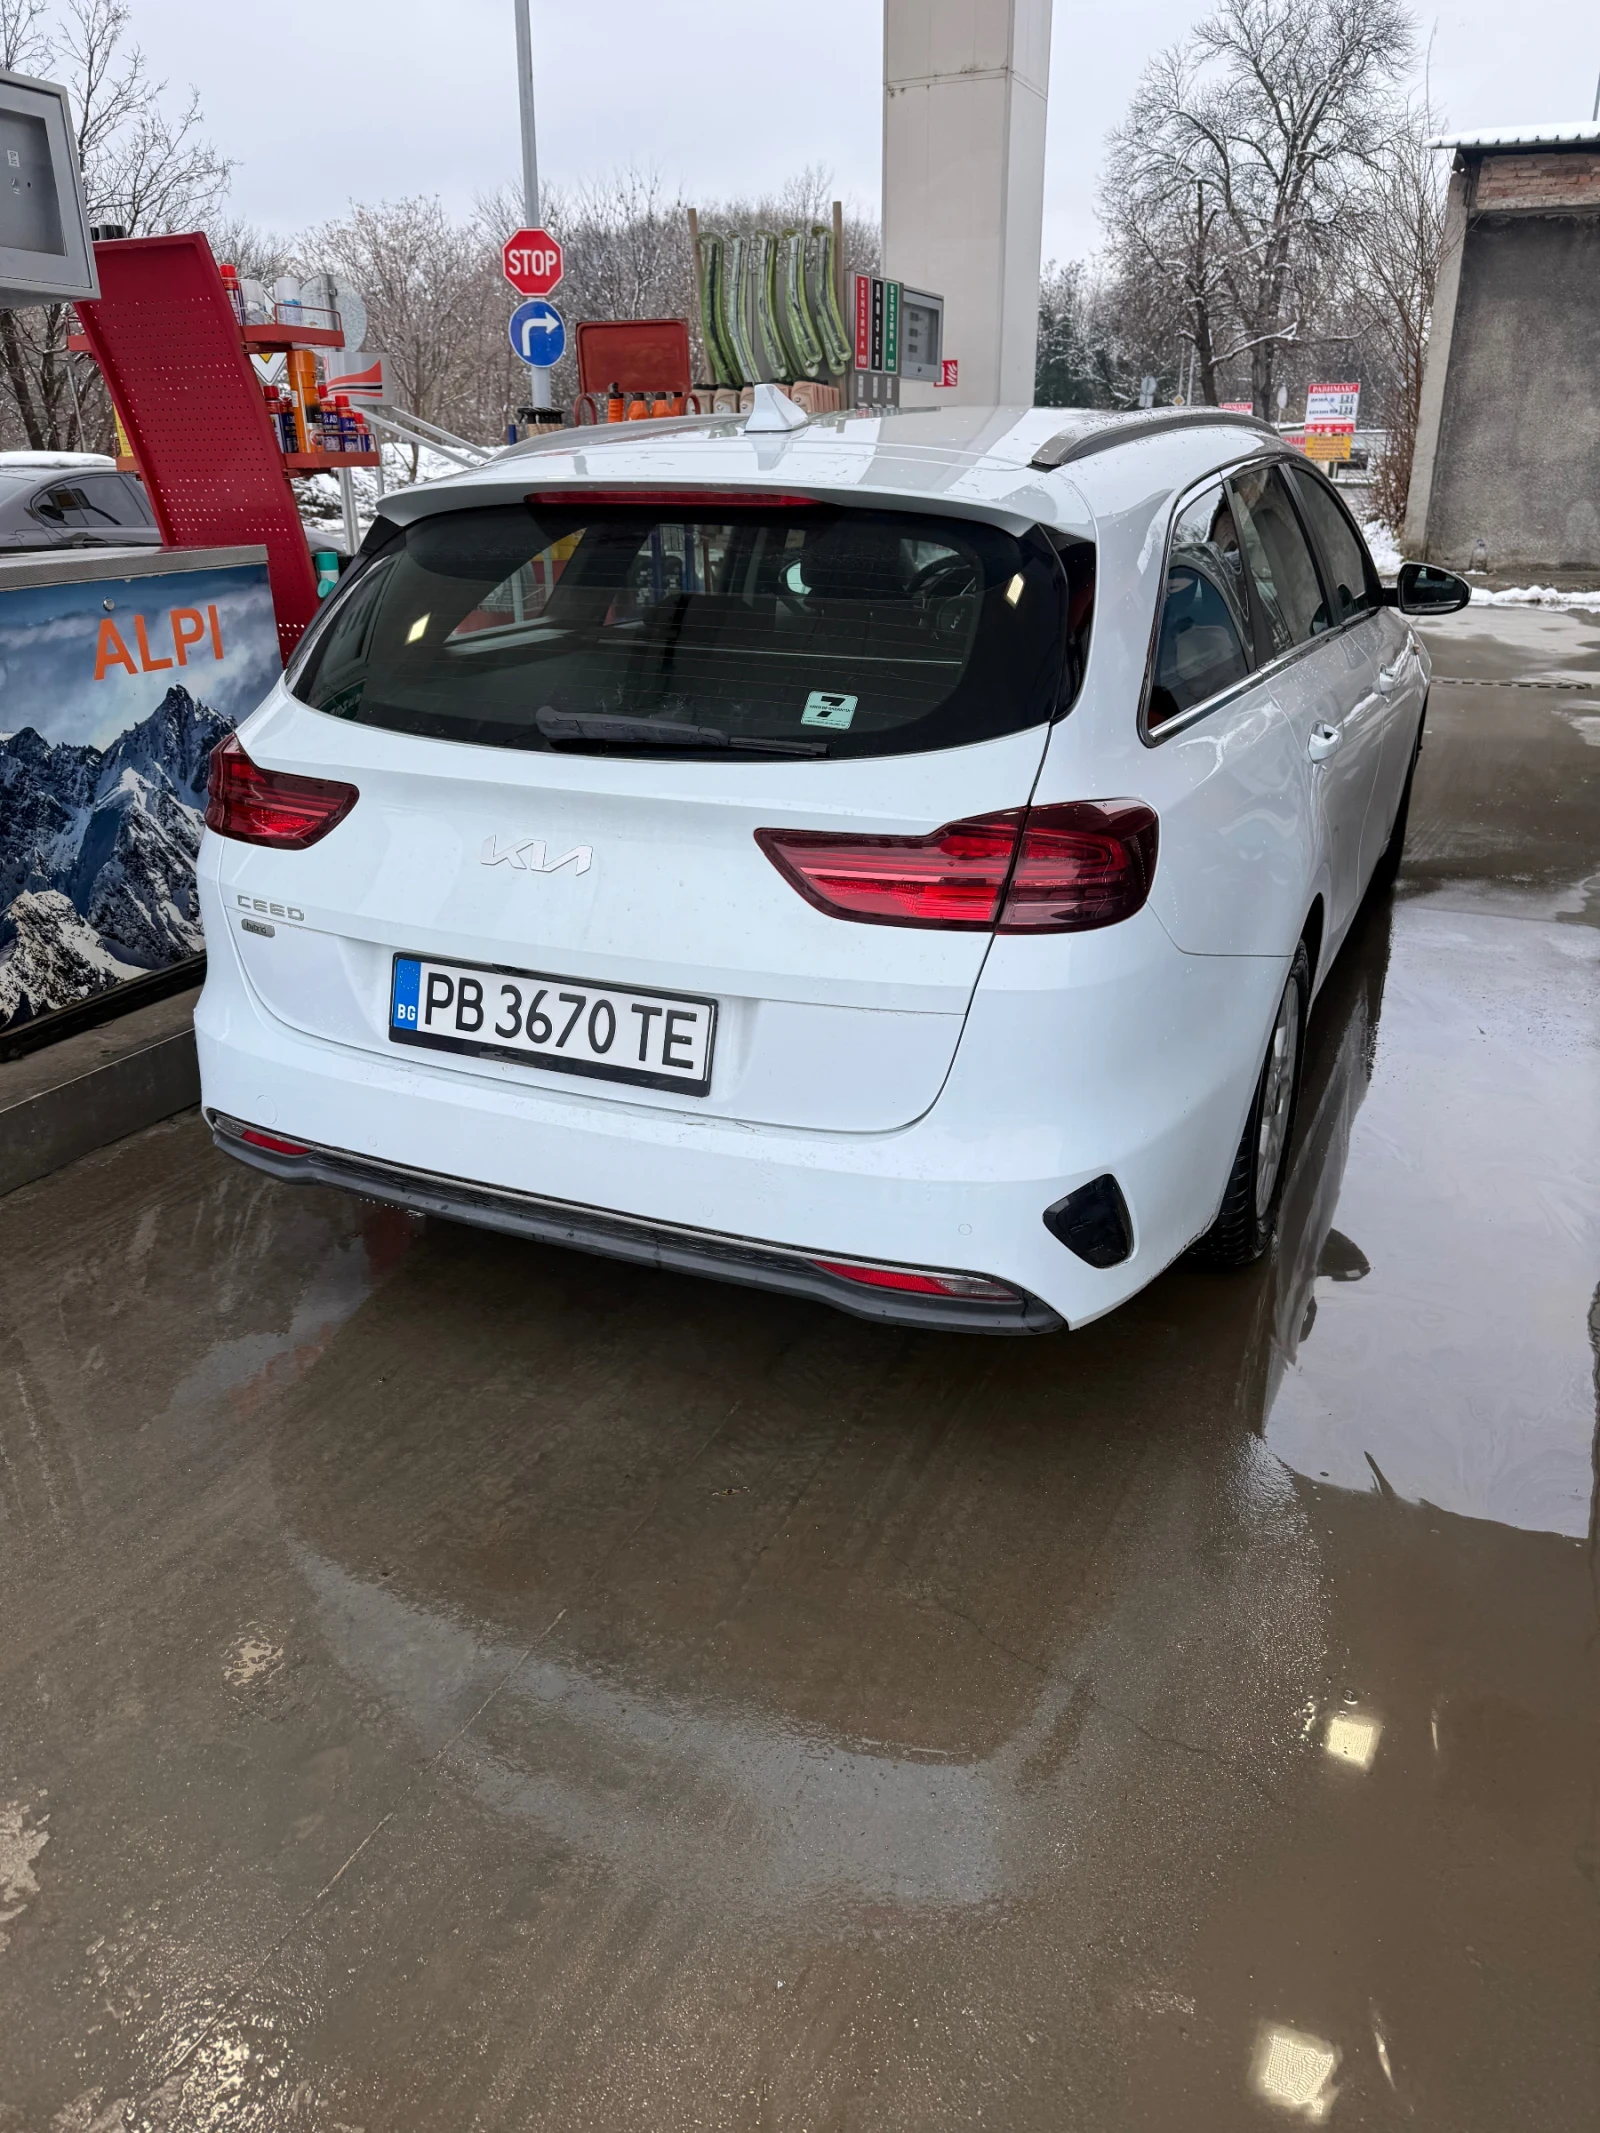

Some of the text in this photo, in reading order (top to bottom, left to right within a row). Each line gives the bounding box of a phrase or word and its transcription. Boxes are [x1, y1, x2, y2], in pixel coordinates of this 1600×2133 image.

[508, 249, 558, 276] STOP
[94, 604, 225, 681] ALPI
[480, 834, 593, 876] KIA
[237, 894, 305, 921] CEED
[246, 920, 267, 934] hybrid
[397, 1004, 416, 1021] BG
[425, 972, 697, 1069] PB 3670 TE
